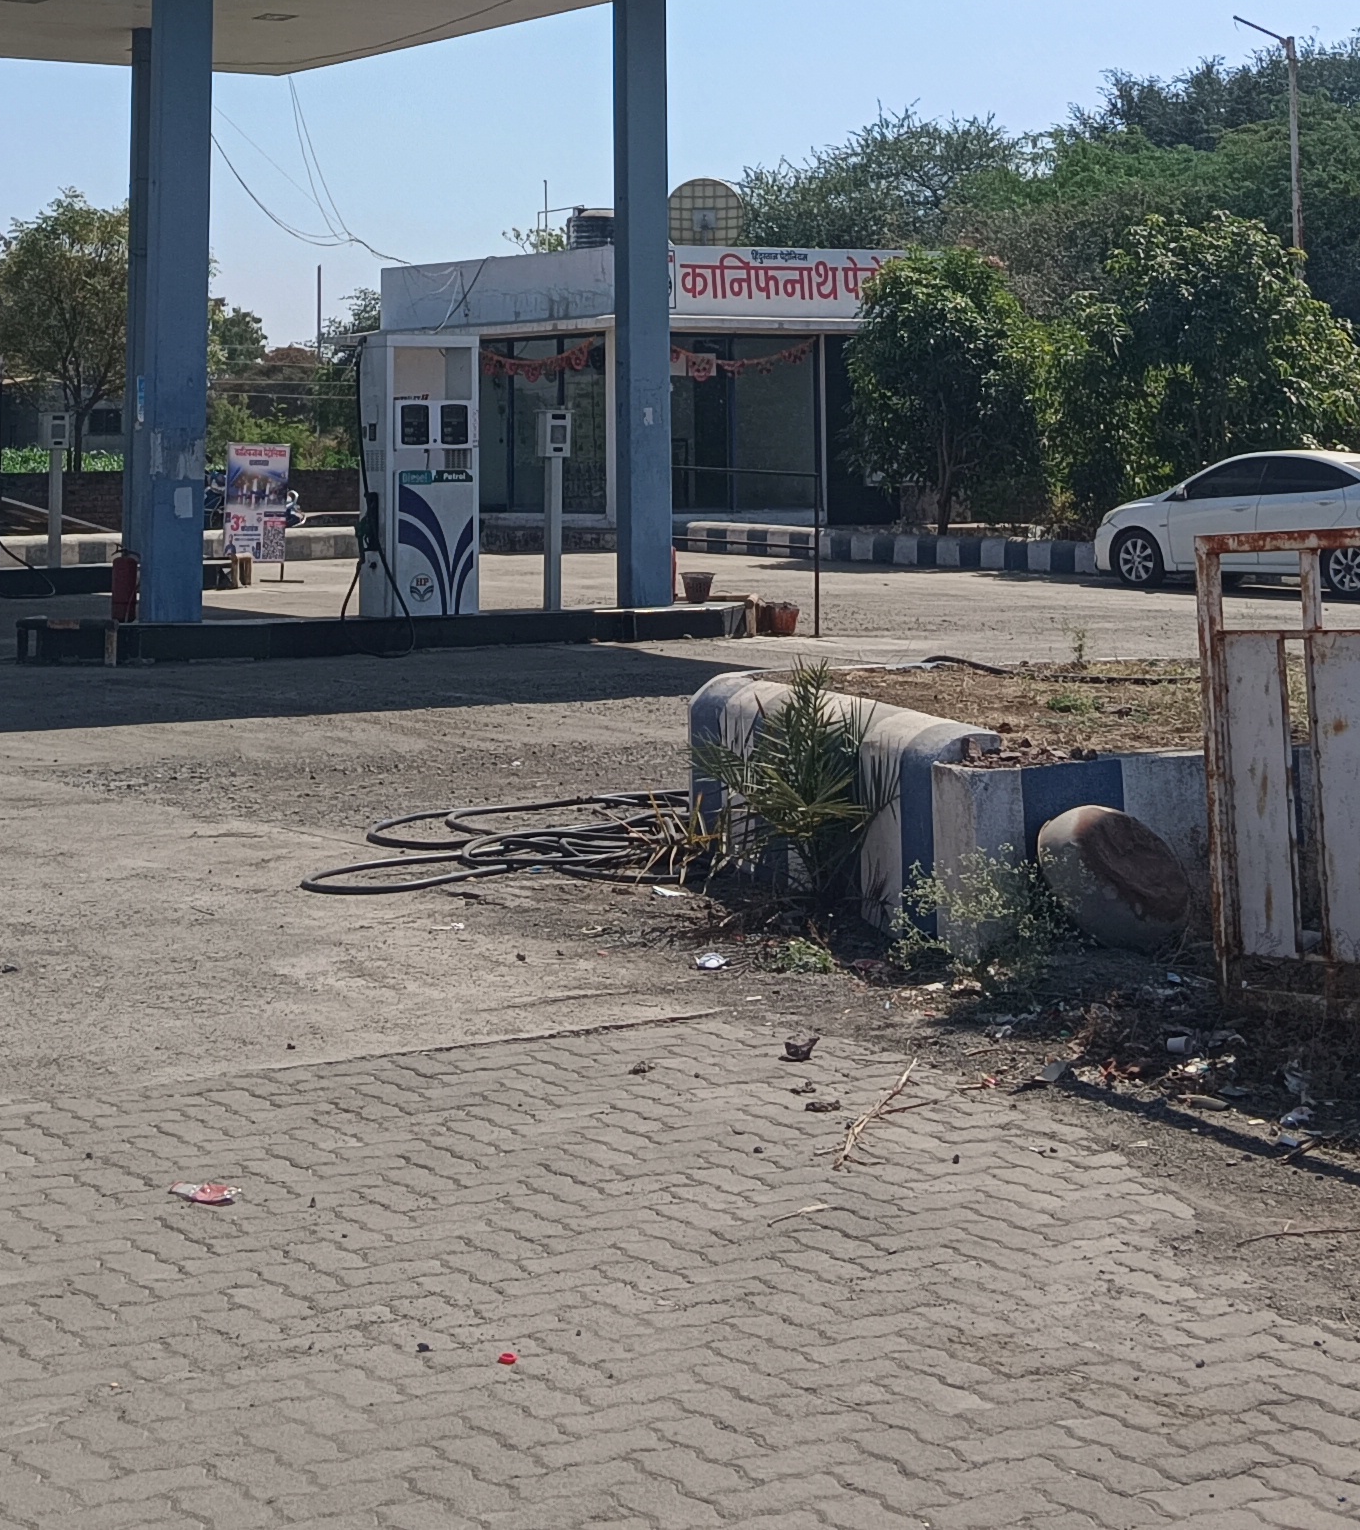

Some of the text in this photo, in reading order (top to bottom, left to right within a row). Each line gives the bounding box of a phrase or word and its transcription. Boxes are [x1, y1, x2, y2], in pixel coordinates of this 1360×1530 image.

[680, 253, 838, 300] कानिफनाथ
[443, 472, 466, 481] Petrol
[416, 577, 429, 587] HP
